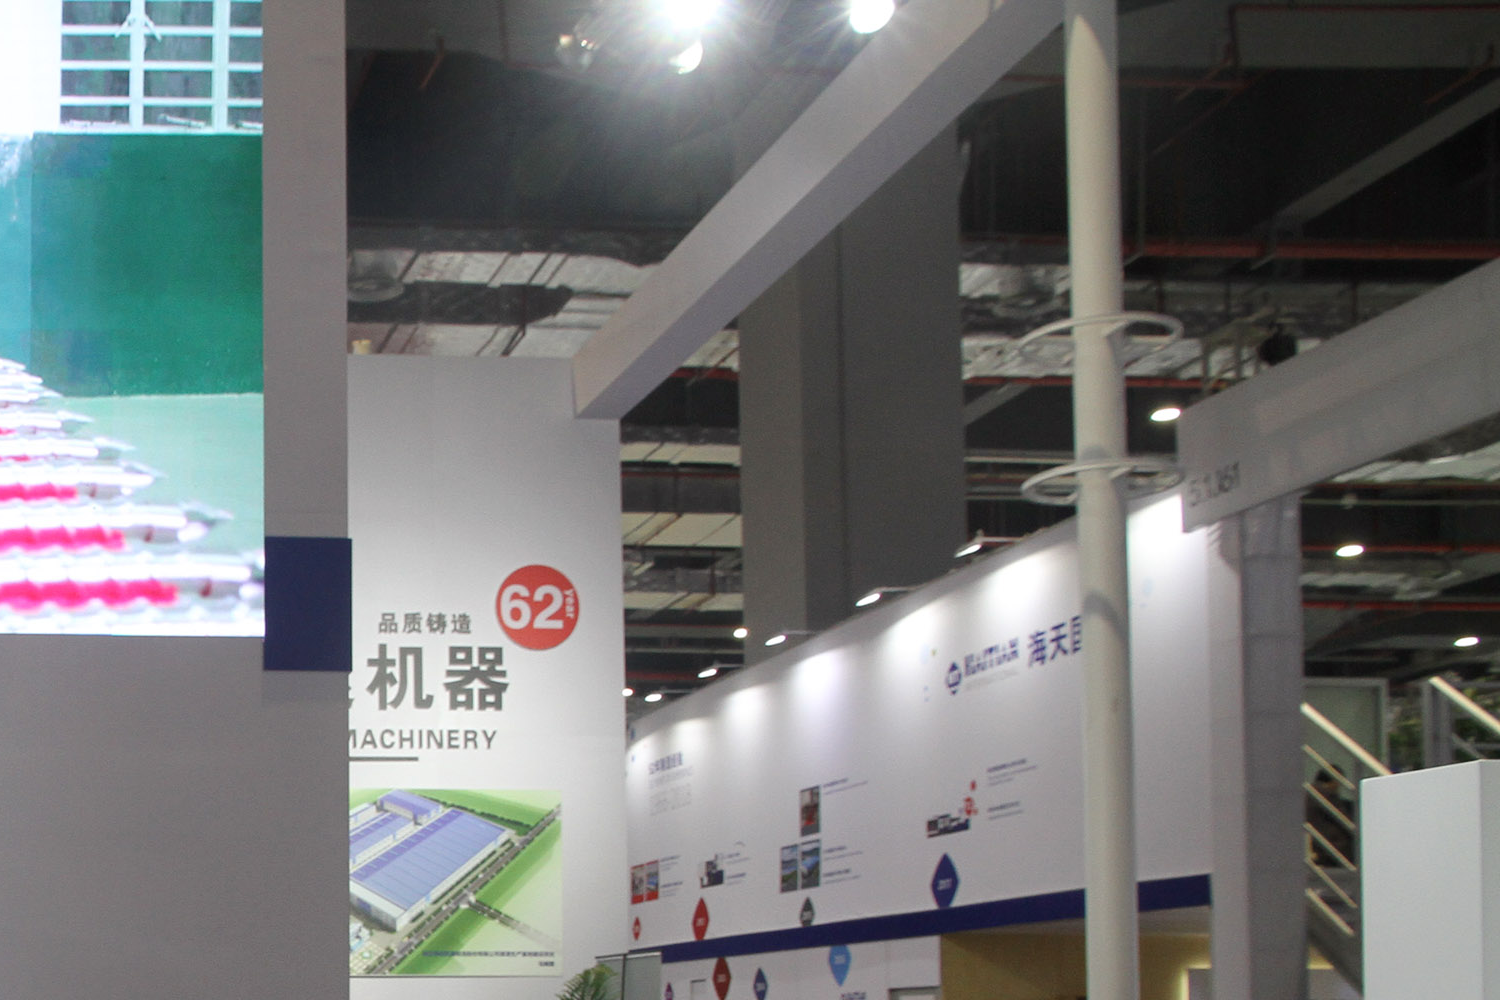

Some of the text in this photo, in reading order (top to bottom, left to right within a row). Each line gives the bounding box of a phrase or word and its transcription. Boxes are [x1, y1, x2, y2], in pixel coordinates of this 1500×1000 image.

[379, 612, 472, 635] 品质铸造
[501, 584, 563, 630] 62
[349, 643, 509, 711] 机器
